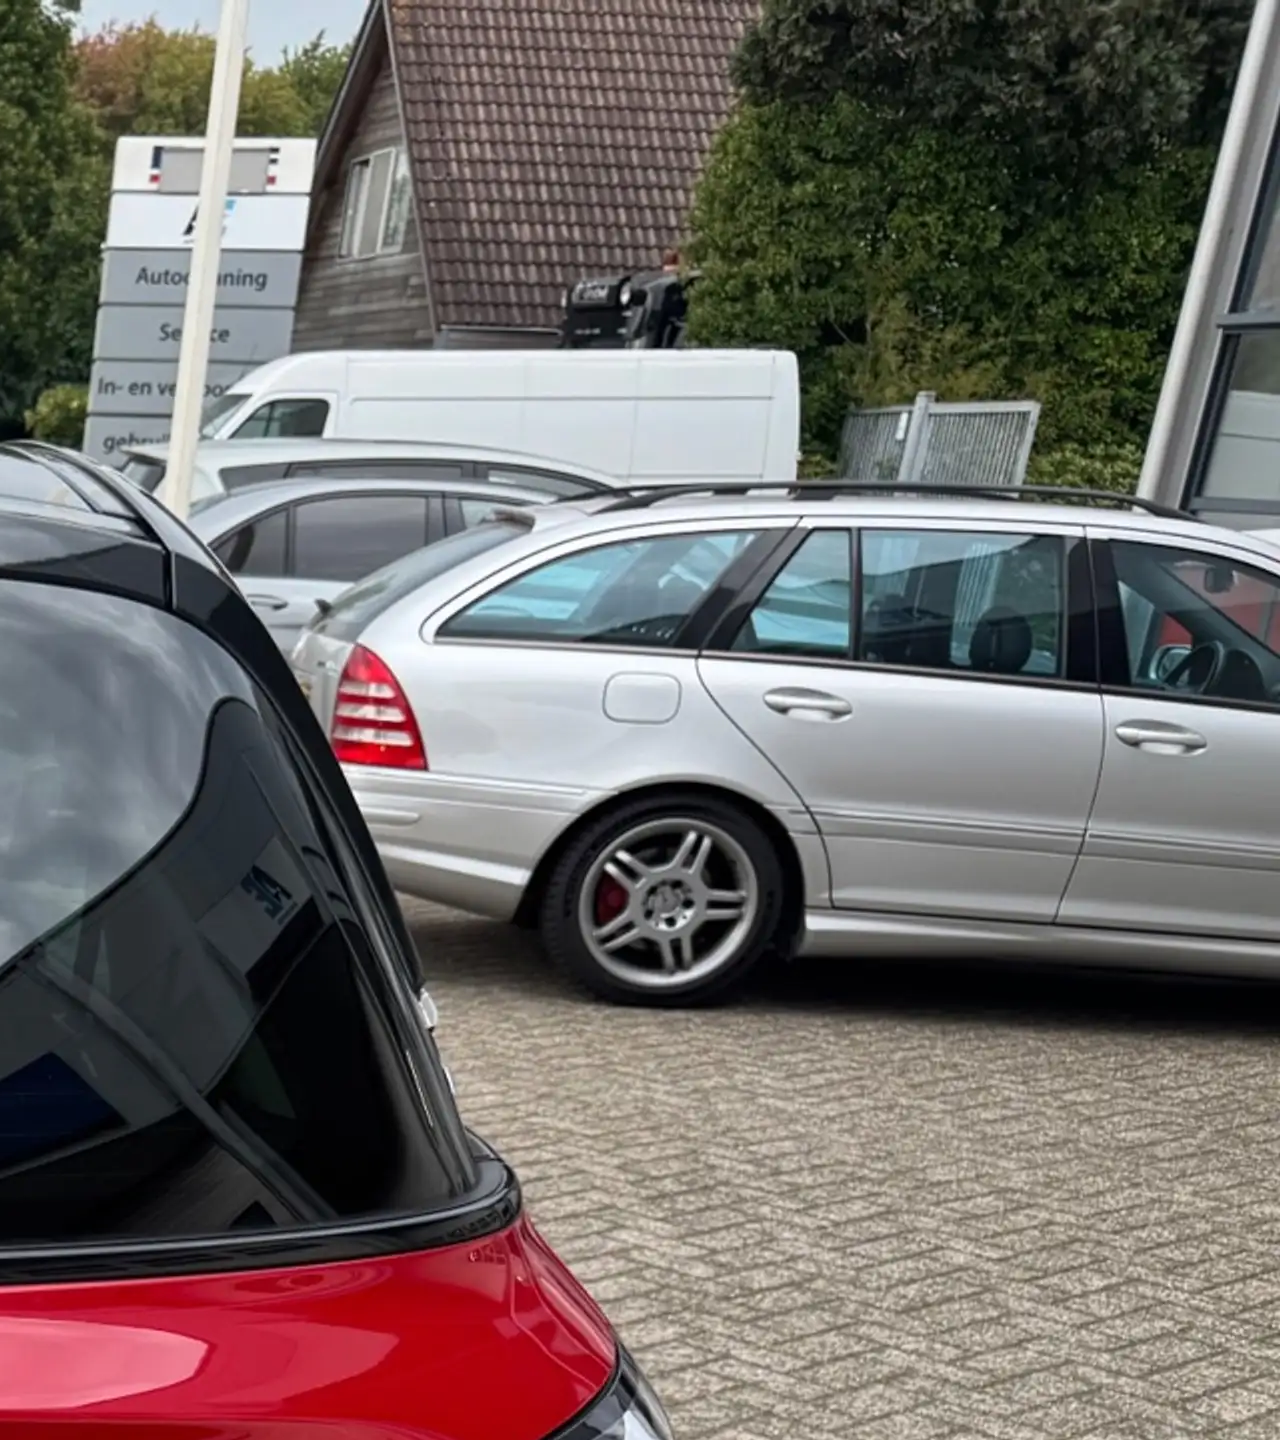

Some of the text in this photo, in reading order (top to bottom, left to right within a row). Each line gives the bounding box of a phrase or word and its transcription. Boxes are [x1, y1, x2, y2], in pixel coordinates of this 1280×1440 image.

[135, 266, 269, 292] Autocning
[158, 323, 231, 343] Sece
[97, 377, 123, 395] In-
[128, 381, 152, 396] en
